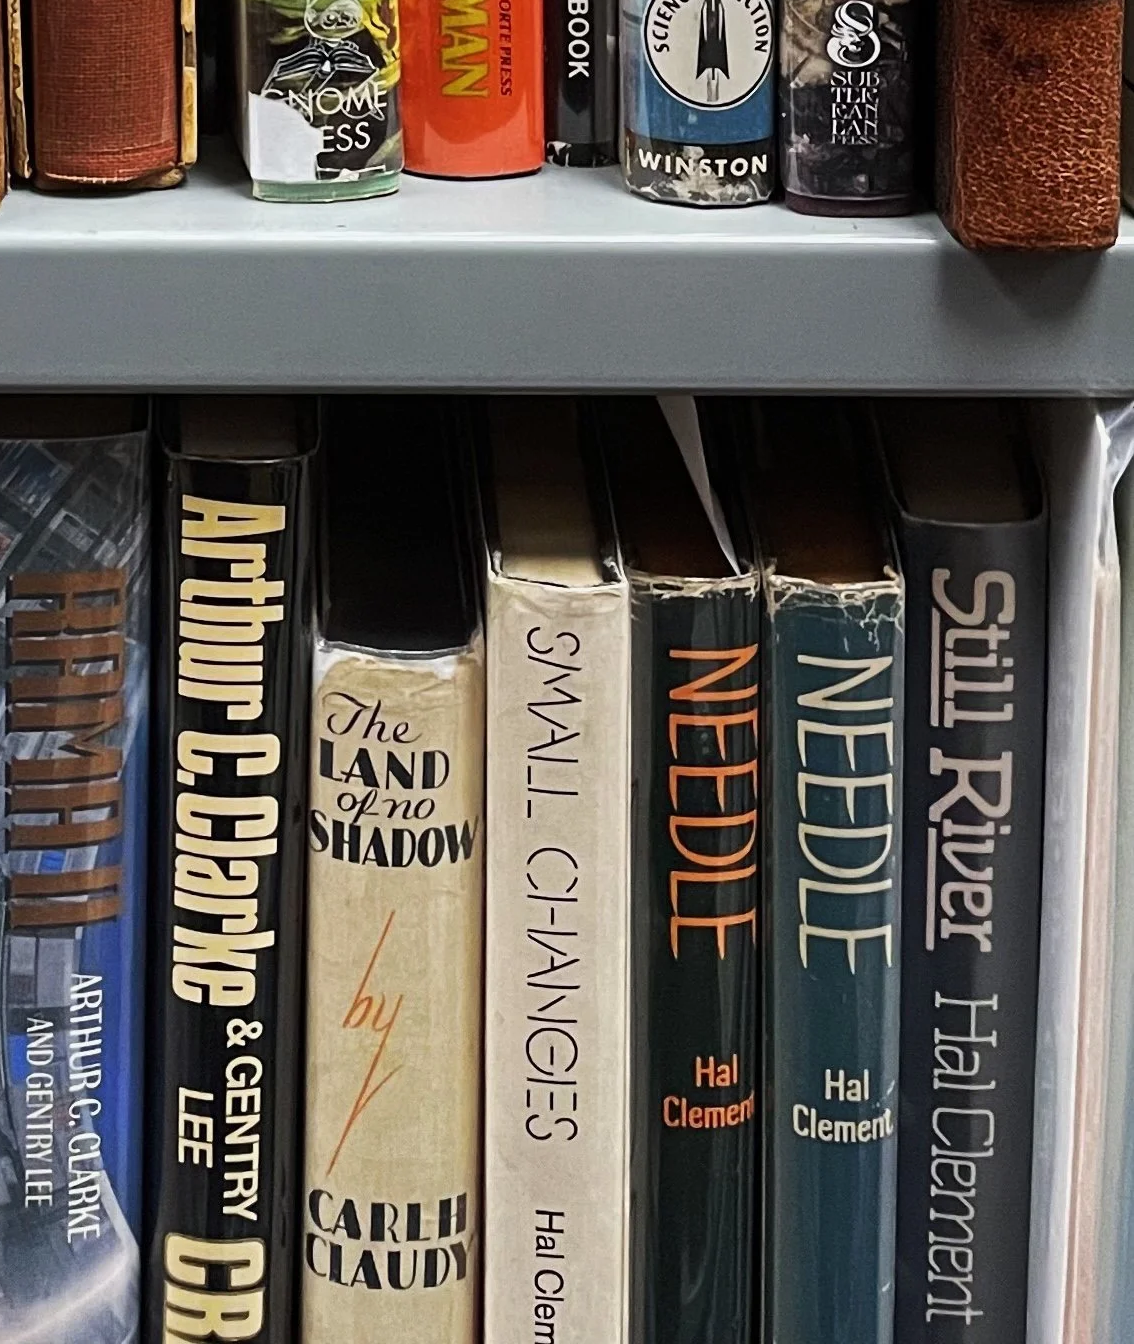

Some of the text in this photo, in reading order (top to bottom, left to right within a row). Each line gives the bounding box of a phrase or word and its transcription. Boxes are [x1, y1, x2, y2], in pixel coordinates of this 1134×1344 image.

[637, 149, 767, 175] WINSTON
[321, 692, 422, 744] The
[526, 626, 581, 818] SMALL
[319, 738, 450, 790] LAND
[669, 644, 758, 960] NEEDLE
[309, 809, 480, 868] SHADOW
[797, 654, 894, 974] NEEDLE
[172, 494, 286, 1221] Arthur C. Clarke & GENTRY
[926, 568, 1016, 1325] Still River Hal Clement
[525, 847, 580, 1141] CHANGES
[66, 974, 103, 1243] ARTHUR C. CLARKE
[695, 1054, 738, 1087] Hal
[824, 1069, 869, 1101] Hal
[25, 1017, 54, 1208] AND GENTRY LEE
[178, 1088, 214, 1168] LEE
[793, 1103, 893, 1143] Clement
[534, 1210, 565, 1257] Hal
